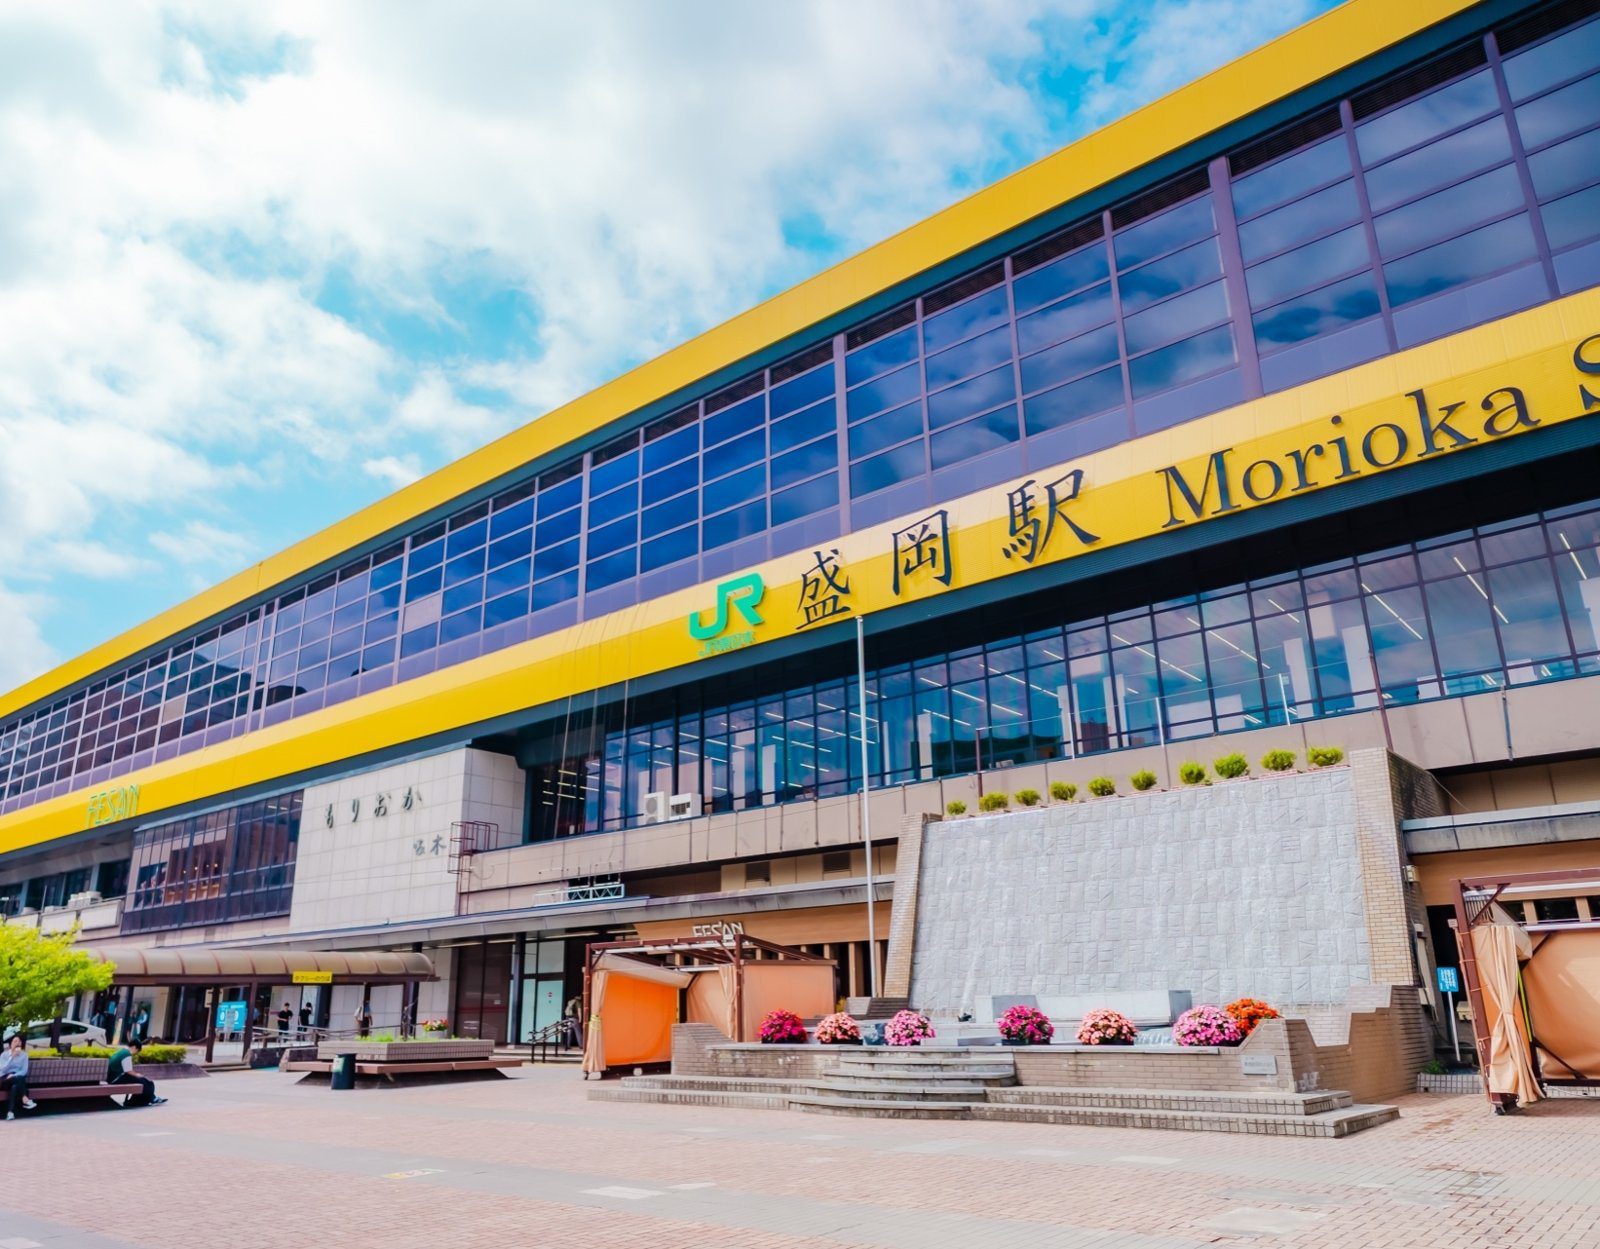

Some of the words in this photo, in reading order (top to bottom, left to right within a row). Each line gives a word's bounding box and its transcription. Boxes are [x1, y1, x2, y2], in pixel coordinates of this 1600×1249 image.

[1155, 386, 1541, 528] Morioka
[796, 469, 1101, 630] 盛岡駅
[690, 572, 764, 640] JR
[325, 787, 422, 829] もりおか
